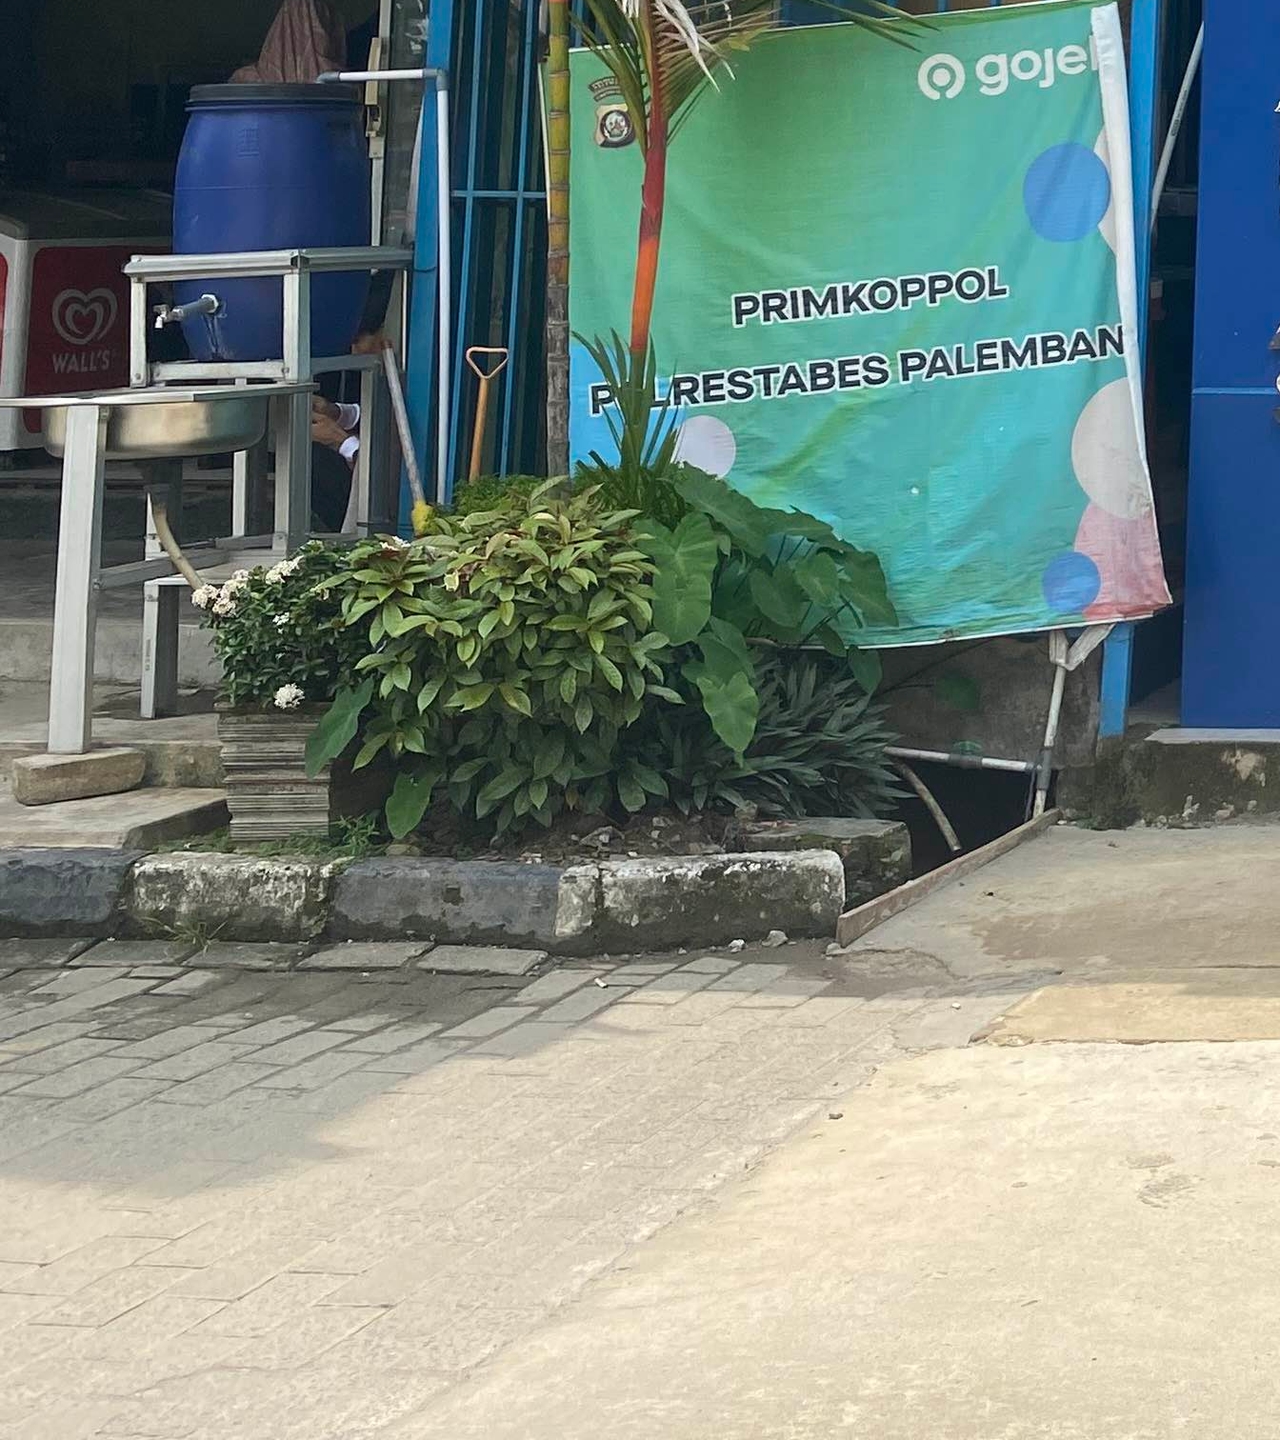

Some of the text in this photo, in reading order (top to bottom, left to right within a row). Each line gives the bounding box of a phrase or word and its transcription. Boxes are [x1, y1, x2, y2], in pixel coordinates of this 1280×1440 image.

[732, 266, 1007, 326] PRIMKOPPOL
[52, 350, 111, 373] WALL'S
[590, 355, 889, 414] PLRESTABES
